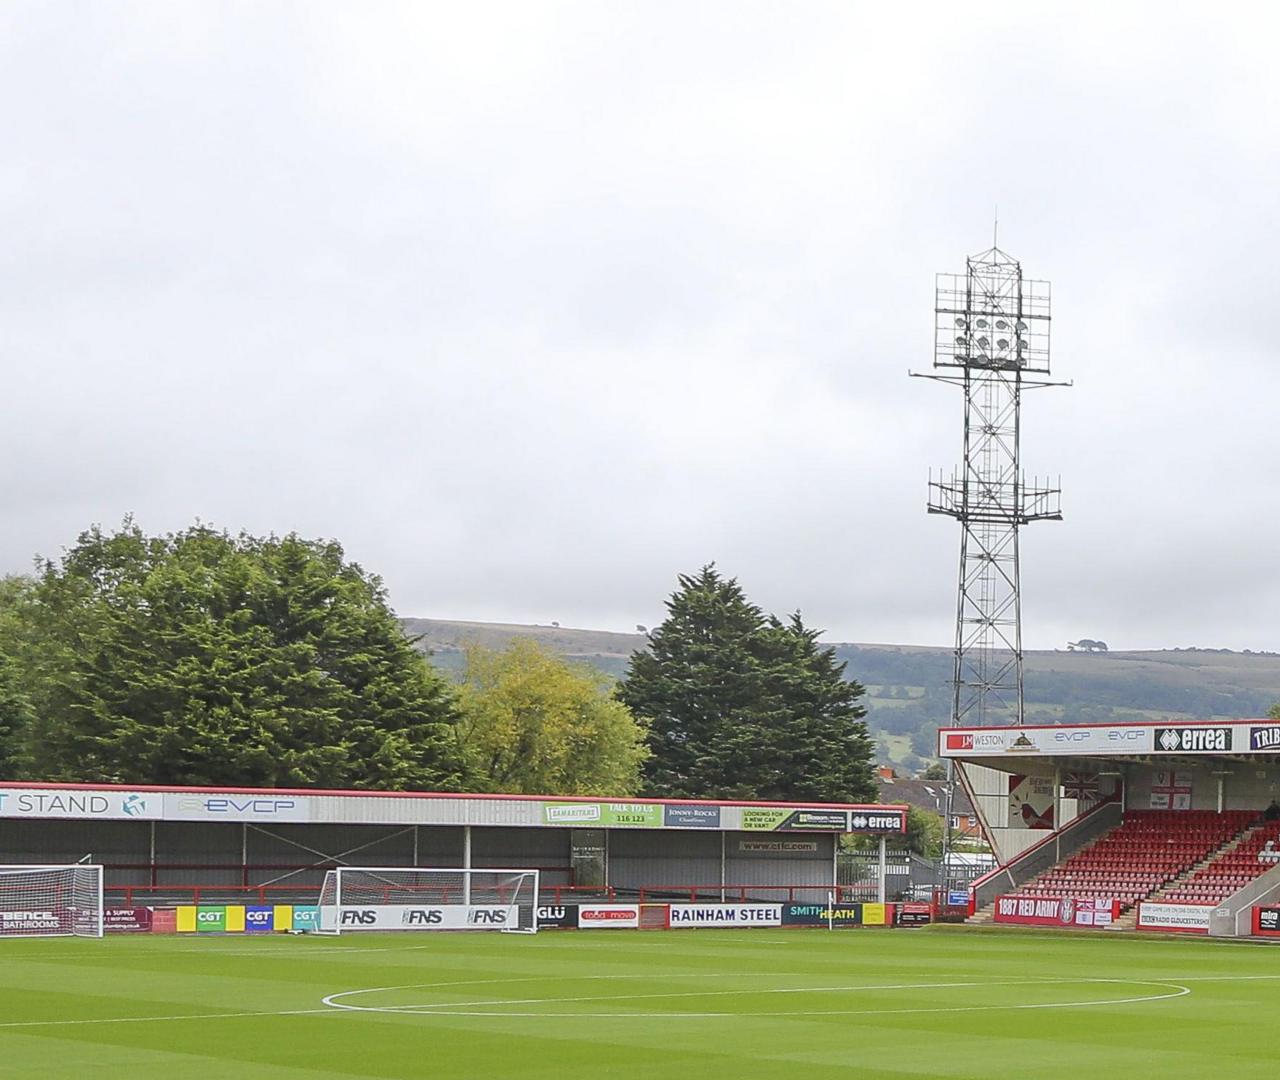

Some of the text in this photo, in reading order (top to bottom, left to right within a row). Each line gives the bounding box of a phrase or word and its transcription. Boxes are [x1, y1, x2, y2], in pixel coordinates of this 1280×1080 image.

[975, 735, 1004, 745] WESTON
[1182, 729, 1226, 750] errea
[18, 795, 109, 814] STAND
[617, 815, 645, 823] 116 123
[868, 816, 900, 829] errea
[791, 907, 823, 916] SMITH
[999, 899, 1058, 917] 1887 RED ARMY
[198, 912, 224, 920] CGT
[247, 912, 272, 920] CGT
[294, 912, 318, 920] CGT
[341, 910, 376, 924] FNS
[408, 910, 442, 924] FNS
[473, 910, 506, 923] FNS
[672, 908, 780, 921] RAINHAM STEEL
[820, 909, 855, 919] HEATH
[3, 920, 59, 929] BATHROOMS
